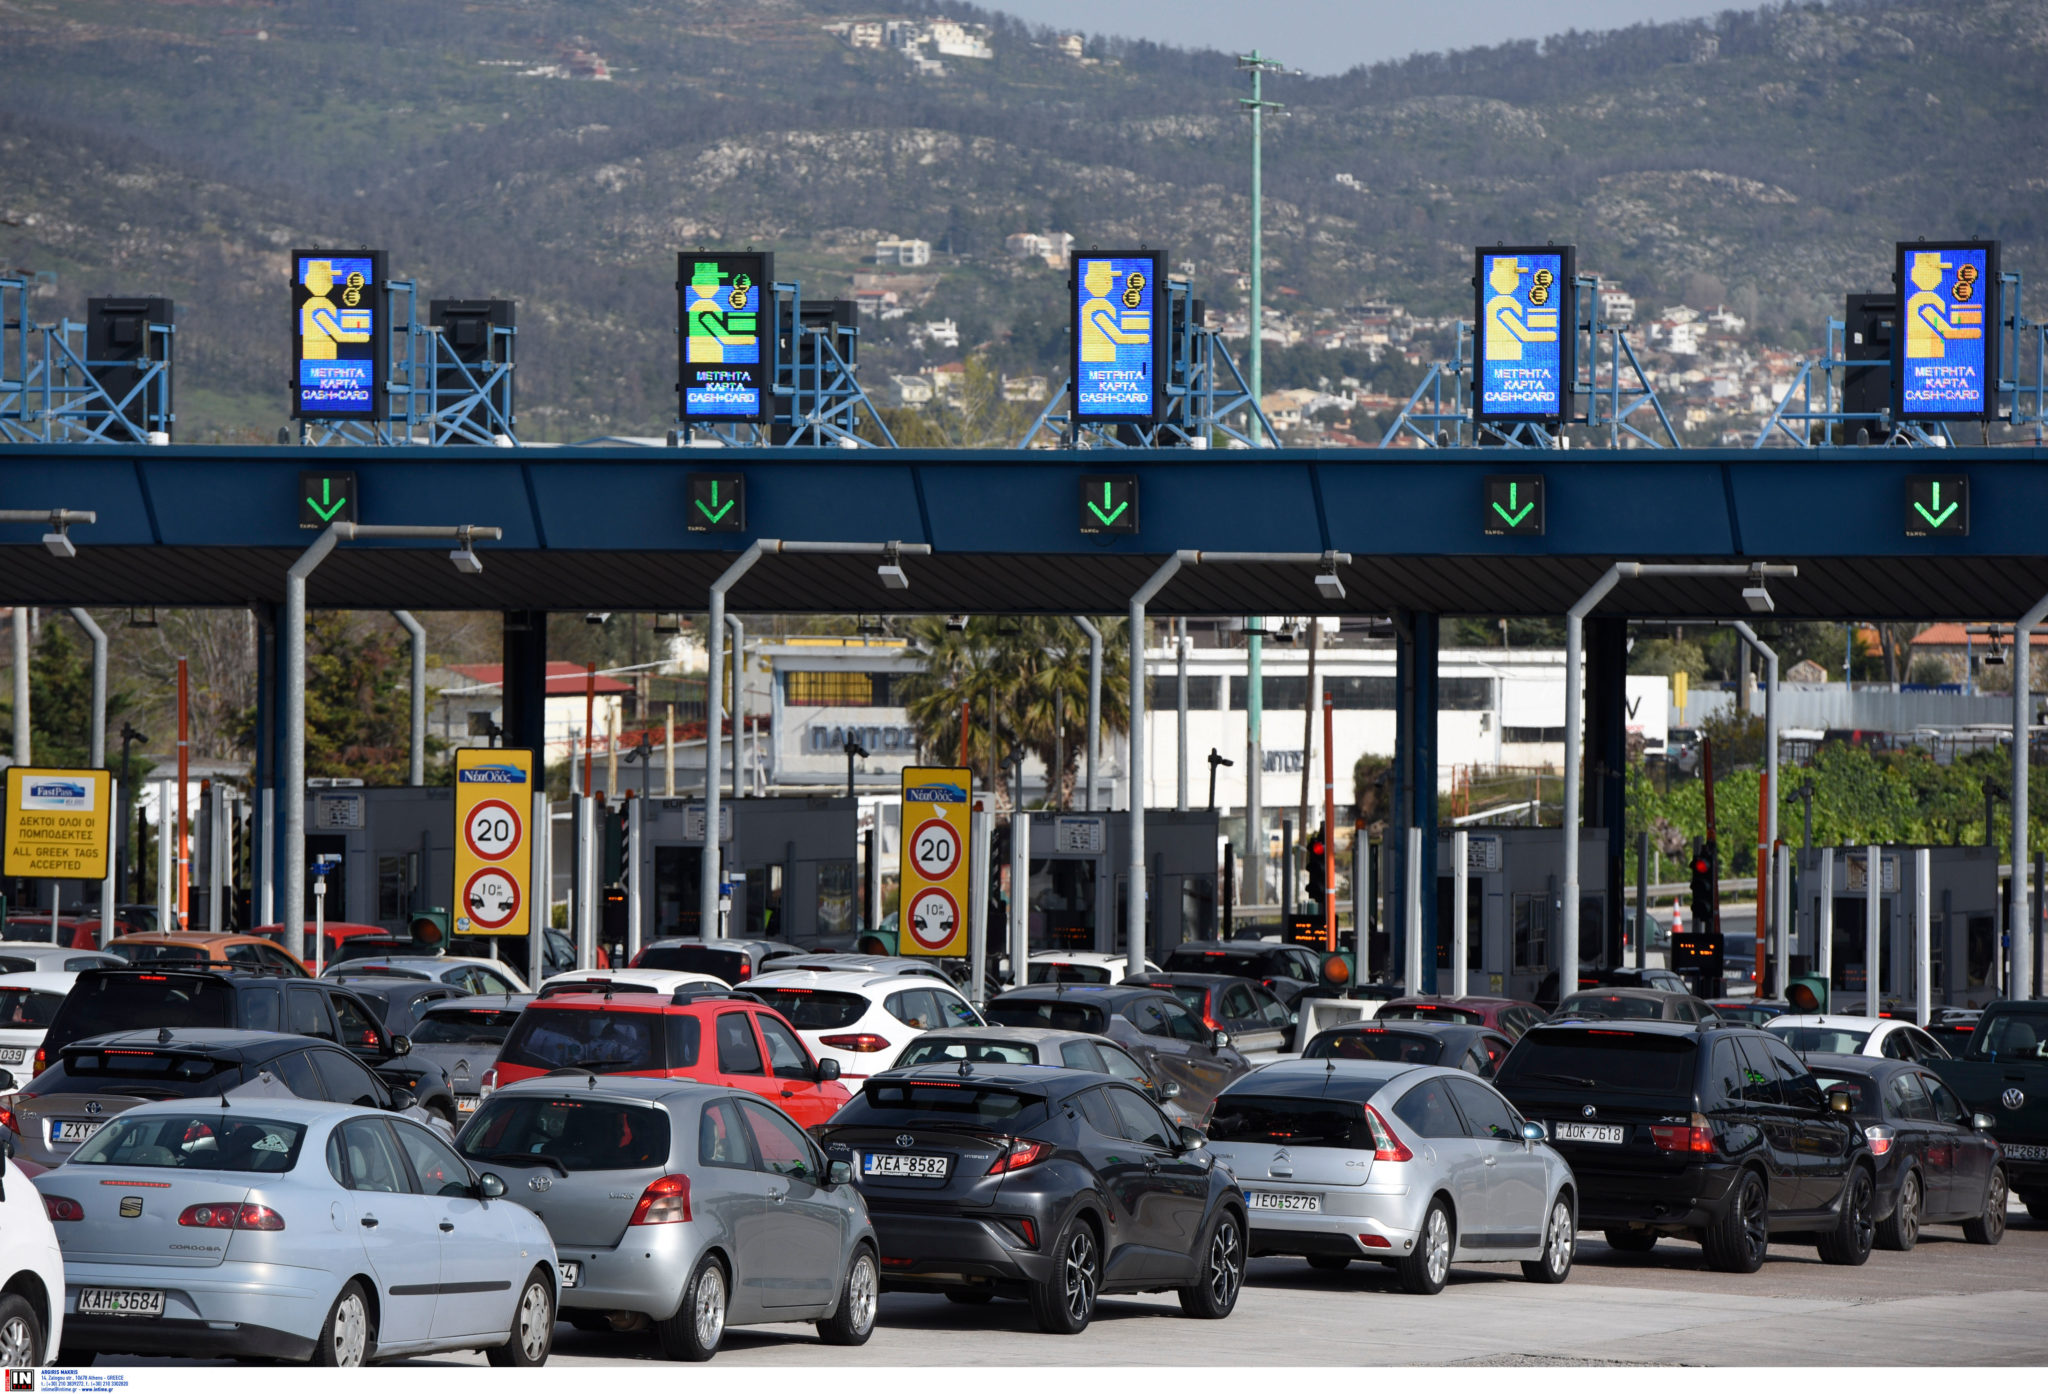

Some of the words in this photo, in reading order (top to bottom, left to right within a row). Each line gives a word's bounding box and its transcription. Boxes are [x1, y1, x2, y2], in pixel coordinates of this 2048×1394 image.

[319, 379, 359, 388] ΚΑΡΤΑ
[706, 382, 746, 392] ΚΑΡΤΑ
[1099, 381, 1138, 391] ΚΑΡΤΑ
[1504, 380, 1545, 390] ΚΑΡΤΑ
[1925, 378, 1969, 388] ΚΑΡΤΑ
[37, 786, 73, 797] FastPass
[19, 816, 55, 826] ΔΕΚΤΟΙ
[58, 817, 81, 827] ΟΛΟΙ
[85, 818, 95, 827] ΟΙ
[19, 829, 93, 840] ΠΟΜΠΟΔΕΚΤΕΣ
[477, 819, 509, 842] 20
[13, 846, 31, 856] ALL
[36, 847, 69, 857] GREEK
[75, 848, 99, 858] TAGS
[921, 838, 950, 862] 20
[30, 859, 81, 870] ACCEPTED
[482, 883, 496, 896] 10
[926, 903, 938, 916] 10
[0, 1050, 22, 1060] 039
